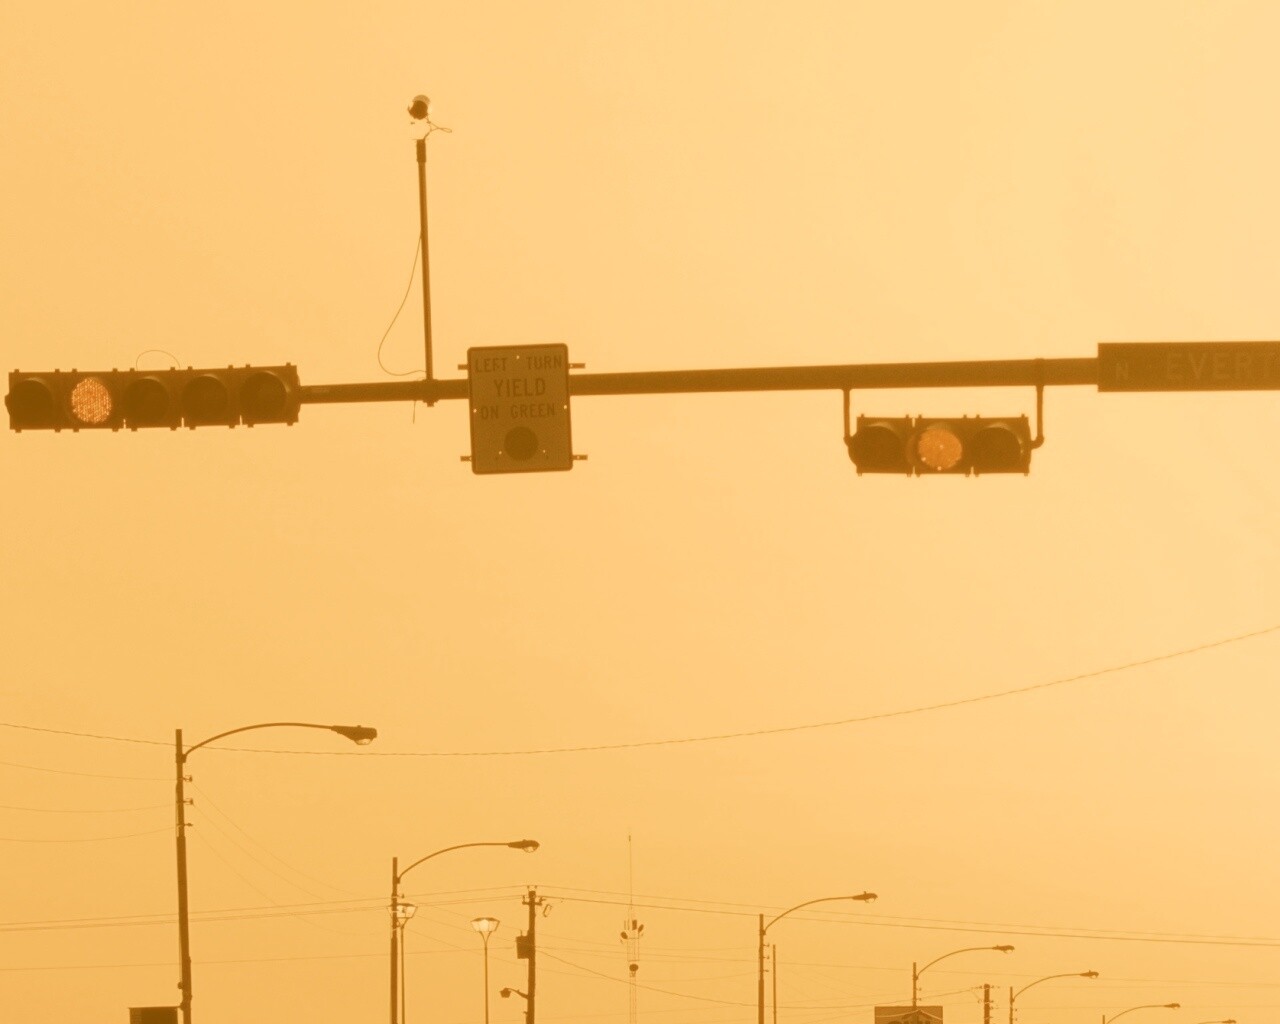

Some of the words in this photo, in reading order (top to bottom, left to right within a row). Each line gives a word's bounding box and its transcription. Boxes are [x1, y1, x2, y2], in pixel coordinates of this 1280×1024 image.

[474, 358, 508, 373] LEFT
[525, 355, 562, 370] TURN
[494, 378, 546, 397] YIELD
[480, 405, 499, 419] ON
[511, 404, 555, 419] GREEN
